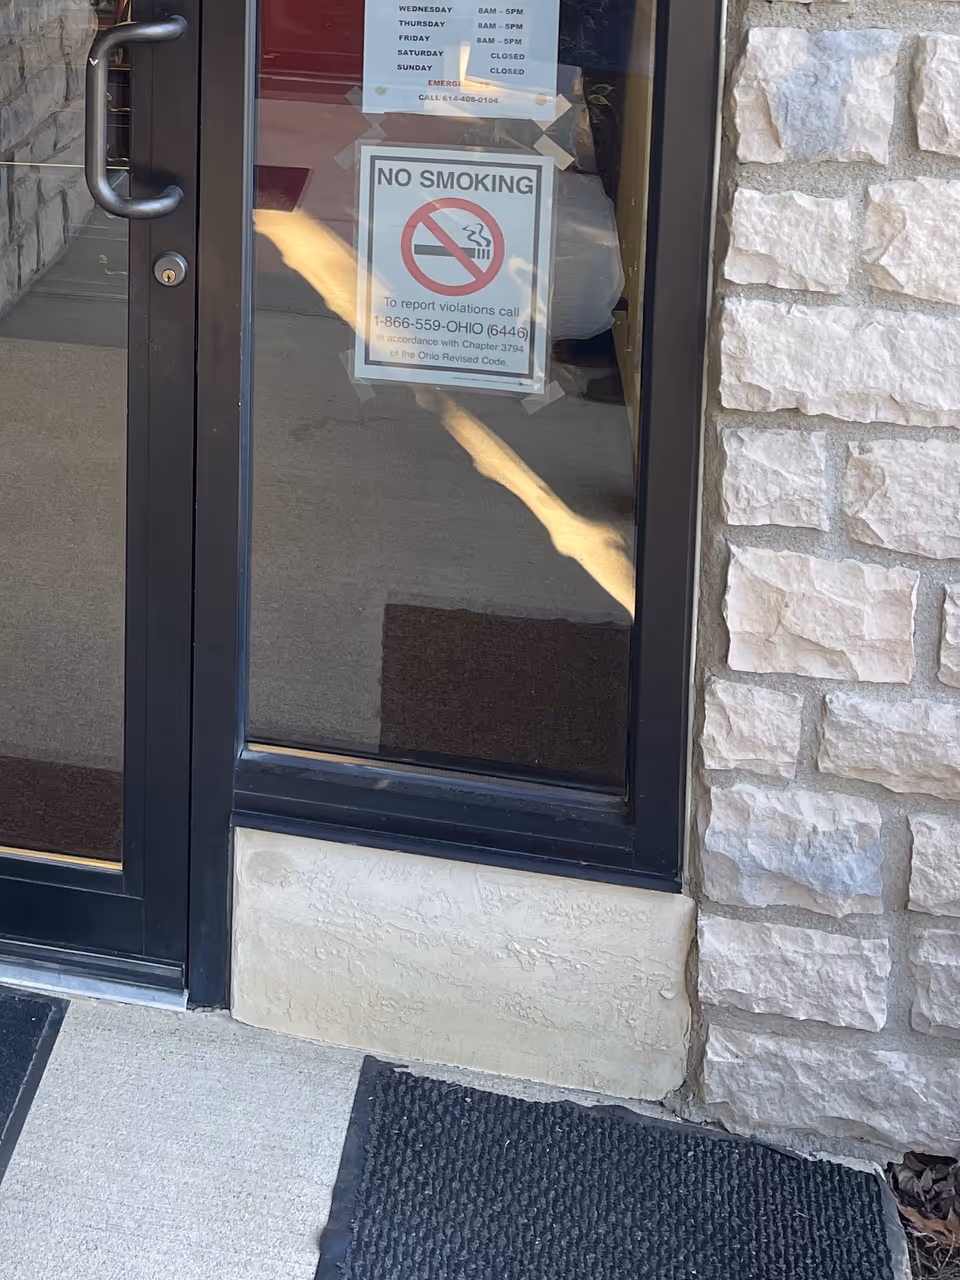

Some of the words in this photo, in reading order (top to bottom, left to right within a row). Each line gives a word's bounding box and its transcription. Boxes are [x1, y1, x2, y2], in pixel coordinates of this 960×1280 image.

[399, 5, 452, 13] WEDNESDAY
[478, 7, 496, 15] 8AM
[477, 22, 496, 30] 8AM
[418, 94, 440, 102] CALL
[442, 95, 499, 104] 614-408-0104
[377, 168, 412, 187] NO
[420, 169, 534, 195] SMOKING
[384, 297, 397, 308] To
[401, 298, 436, 313] report
[440, 301, 495, 316] violations
[499, 307, 520, 318] call
[374, 316, 484, 335] 1-866-559-OHIO
[487, 324, 529, 342] (6446)
[386, 335, 439, 346] accordance
[441, 338, 460, 348] with
[462, 340, 498, 352] Chapter
[501, 344, 525, 353] 3794
[401, 350, 415, 358] the
[418, 351, 440, 360] Ohio
[442, 353, 479, 364] Revised
[481, 356, 509, 367] Code.
